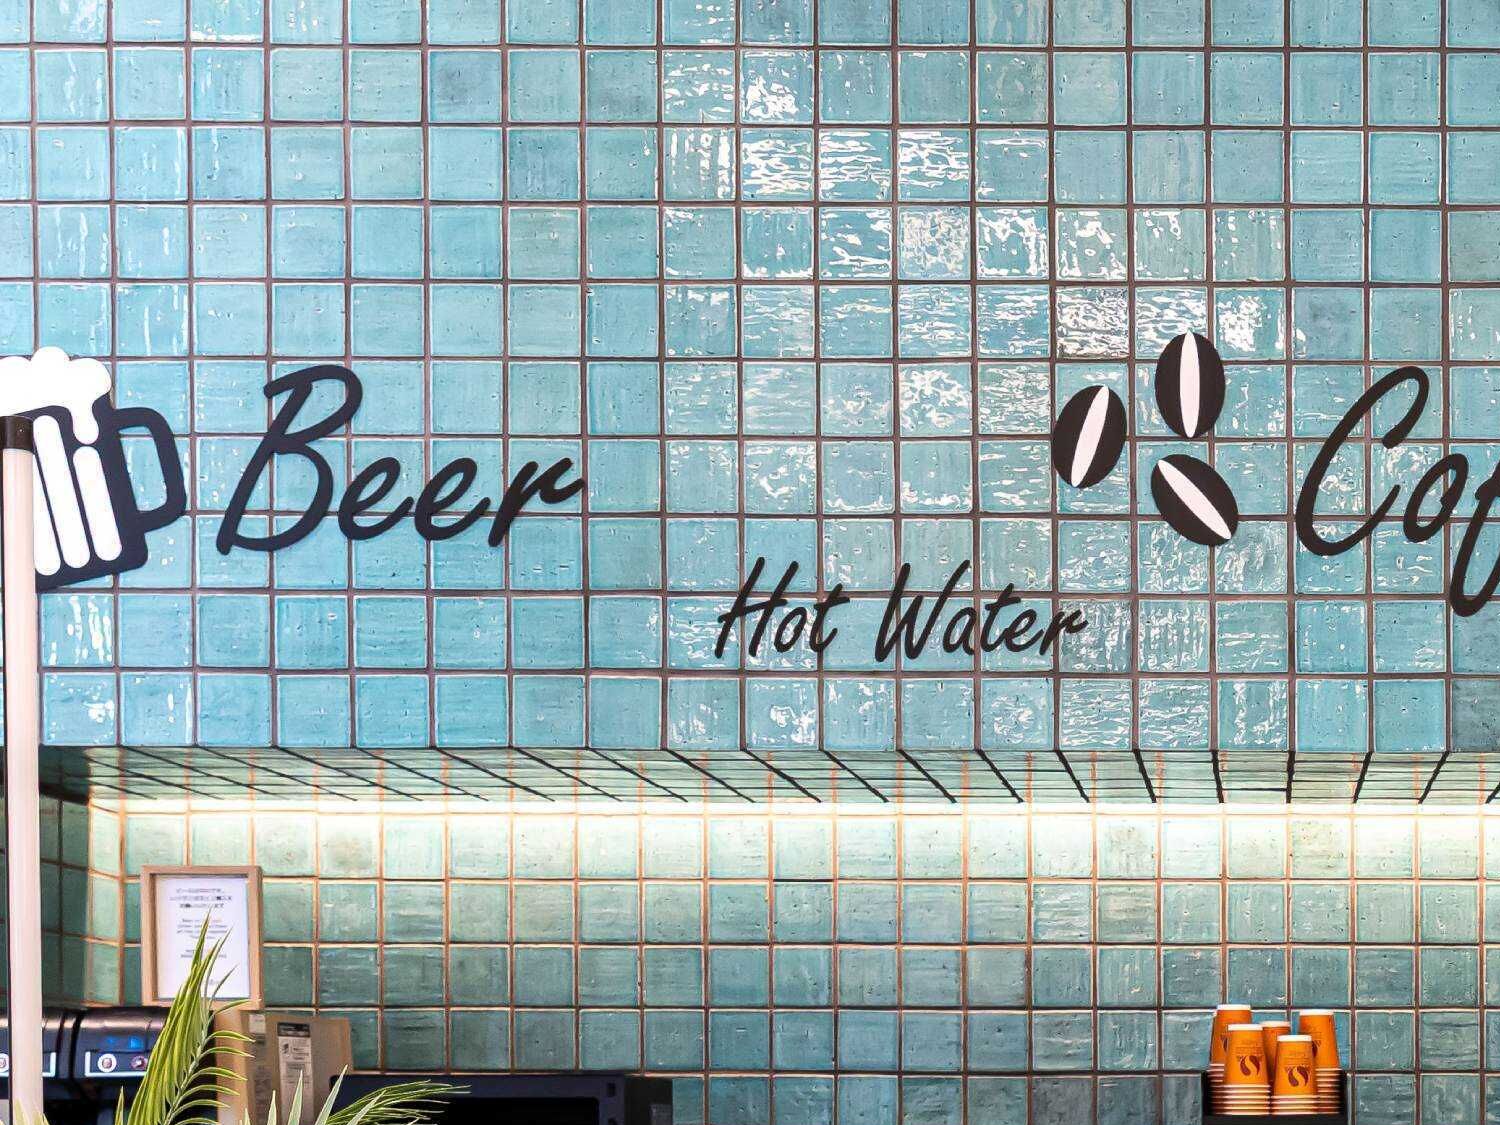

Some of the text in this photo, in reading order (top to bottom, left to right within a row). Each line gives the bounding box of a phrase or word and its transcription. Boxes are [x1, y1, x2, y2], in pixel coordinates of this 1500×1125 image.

[216, 364, 586, 556] Beer
[714, 556, 1090, 663] Hot Water
